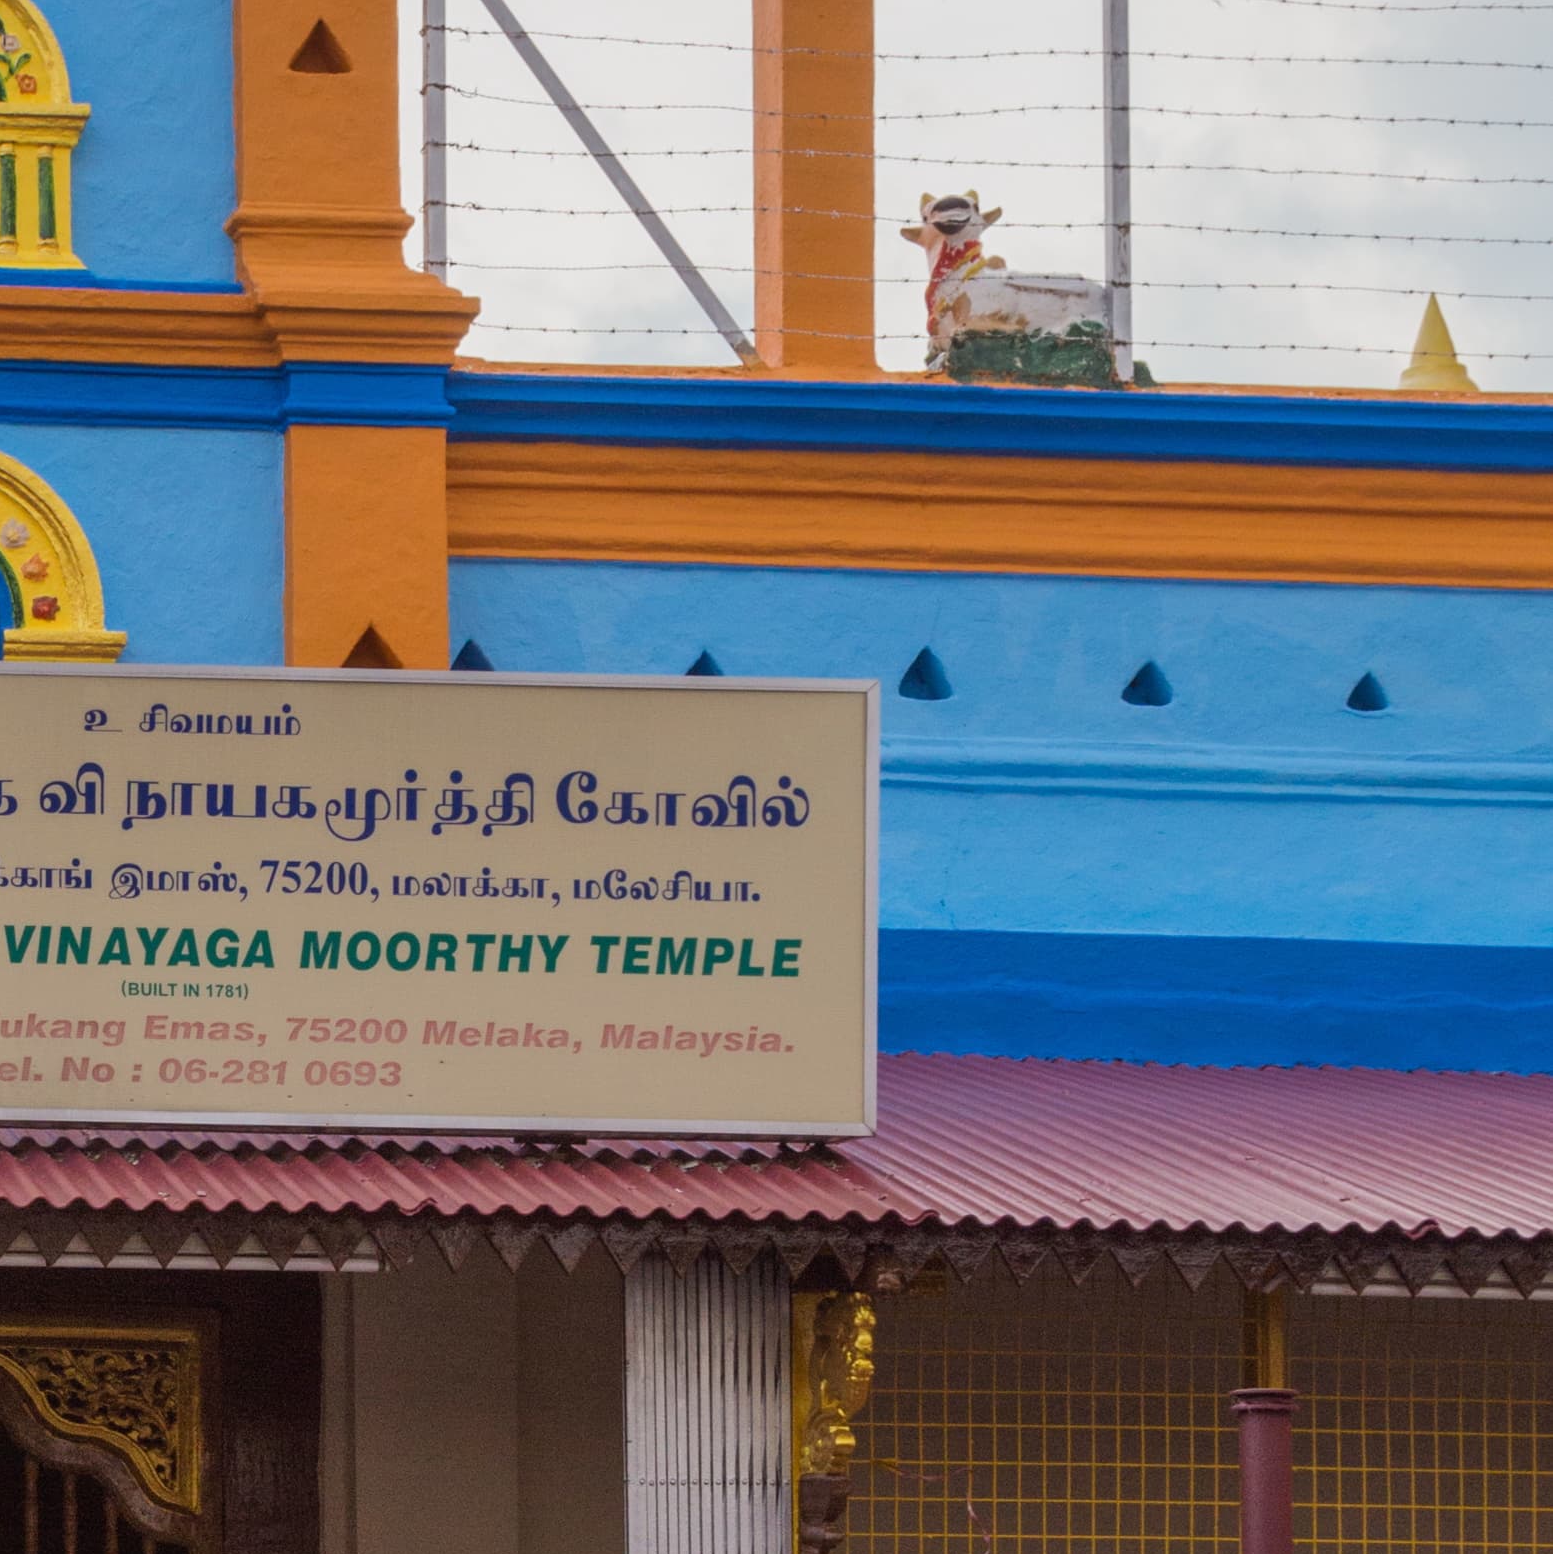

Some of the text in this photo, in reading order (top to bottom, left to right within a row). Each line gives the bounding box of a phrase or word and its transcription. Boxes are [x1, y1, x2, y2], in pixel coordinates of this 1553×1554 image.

[139, 703, 301, 735] சிவமயம்
[556, 771, 809, 827] கோவில்
[260, 860, 379, 902] 75200,
[393, 867, 560, 907] மலாக்கா,
[574, 869, 760, 902] மலேசியா.
[4, 925, 274, 968] VINAYAGA
[300, 931, 570, 973] MOORTHY
[590, 936, 802, 977] TEMPLE
[121, 980, 249, 1000] (BUILT IN 1781)
[144, 1015, 267, 1047] Emas,
[286, 1017, 407, 1043] 75200
[422, 1020, 582, 1054] Melaka,
[600, 1024, 794, 1058] Malaysia.
[60, 1057, 115, 1083] No
[159, 1058, 287, 1085] 06-281
[305, 1060, 401, 1086] 0693
